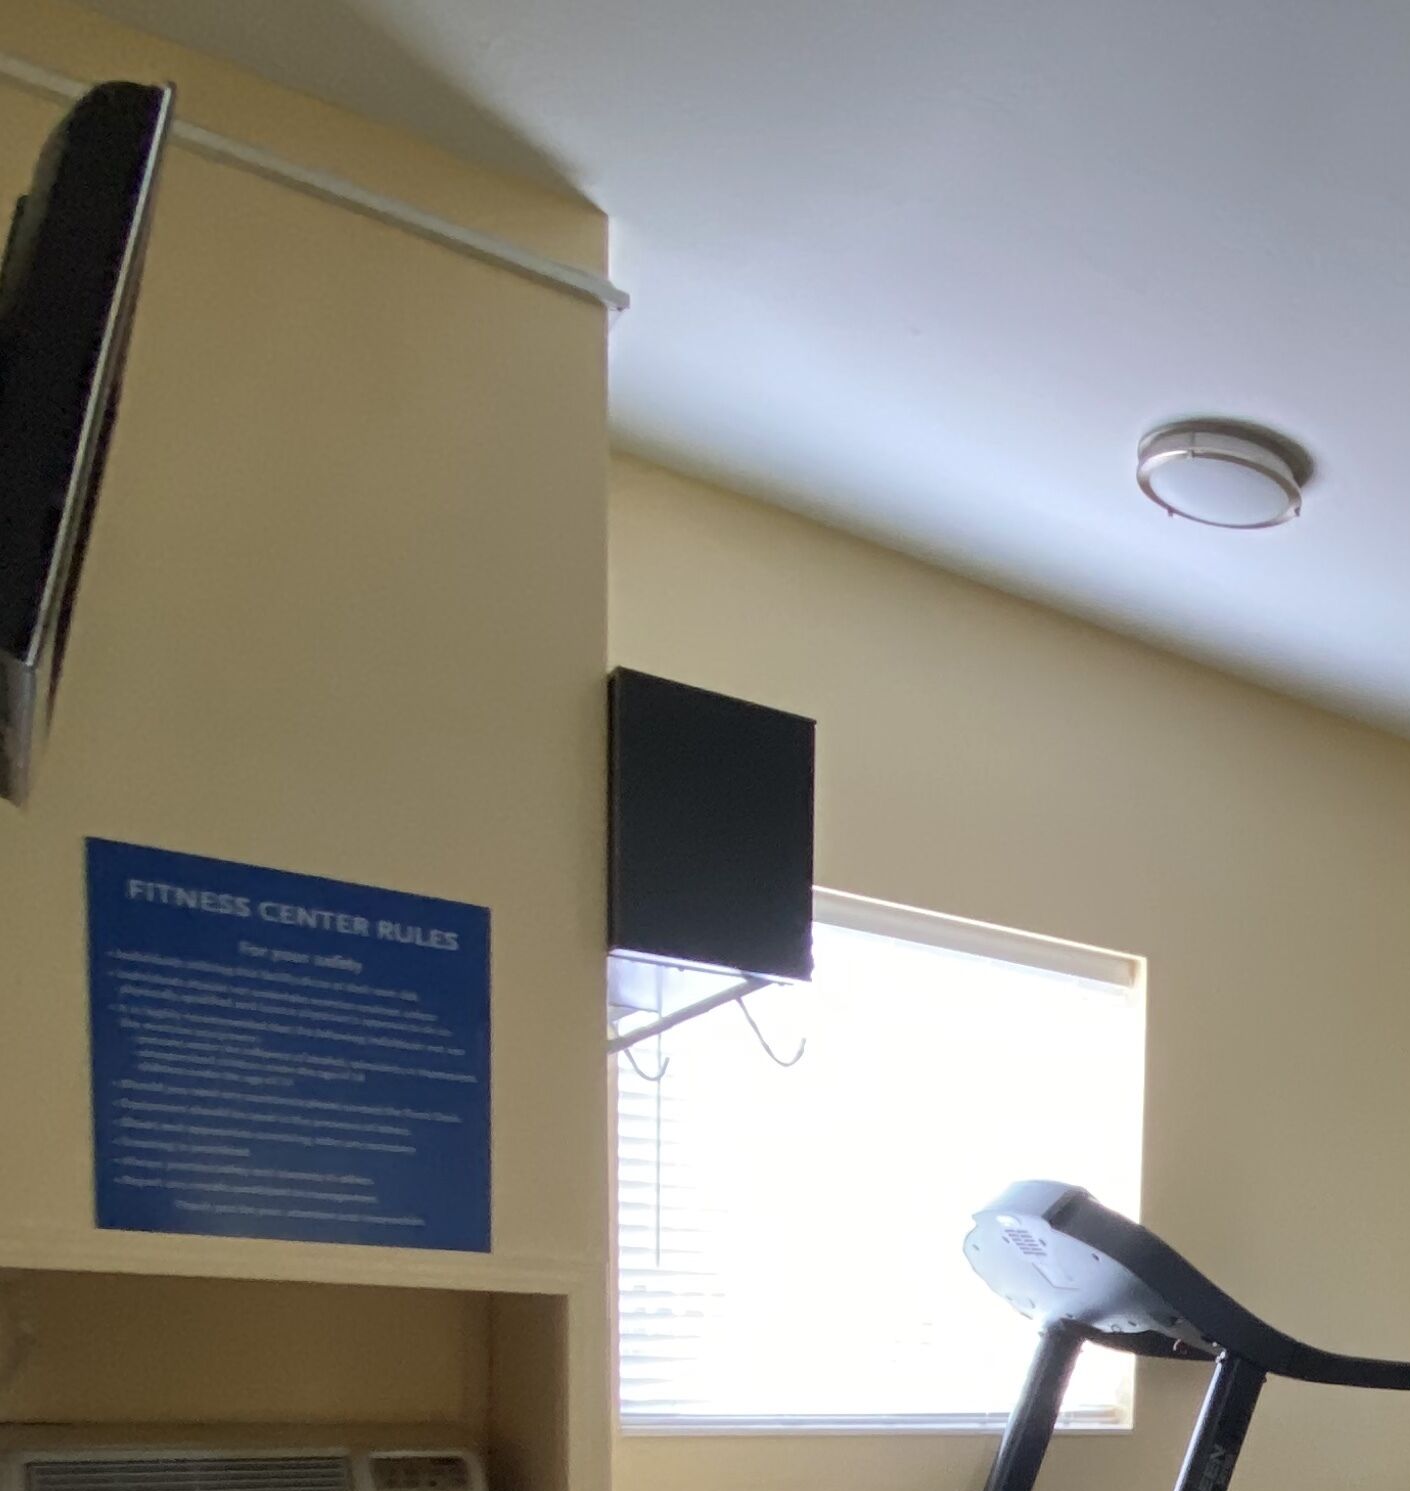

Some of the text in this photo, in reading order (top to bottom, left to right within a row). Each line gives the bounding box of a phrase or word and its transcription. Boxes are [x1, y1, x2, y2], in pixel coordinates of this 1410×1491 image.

[127, 879, 459, 950] FITNESS CENTER RULES
